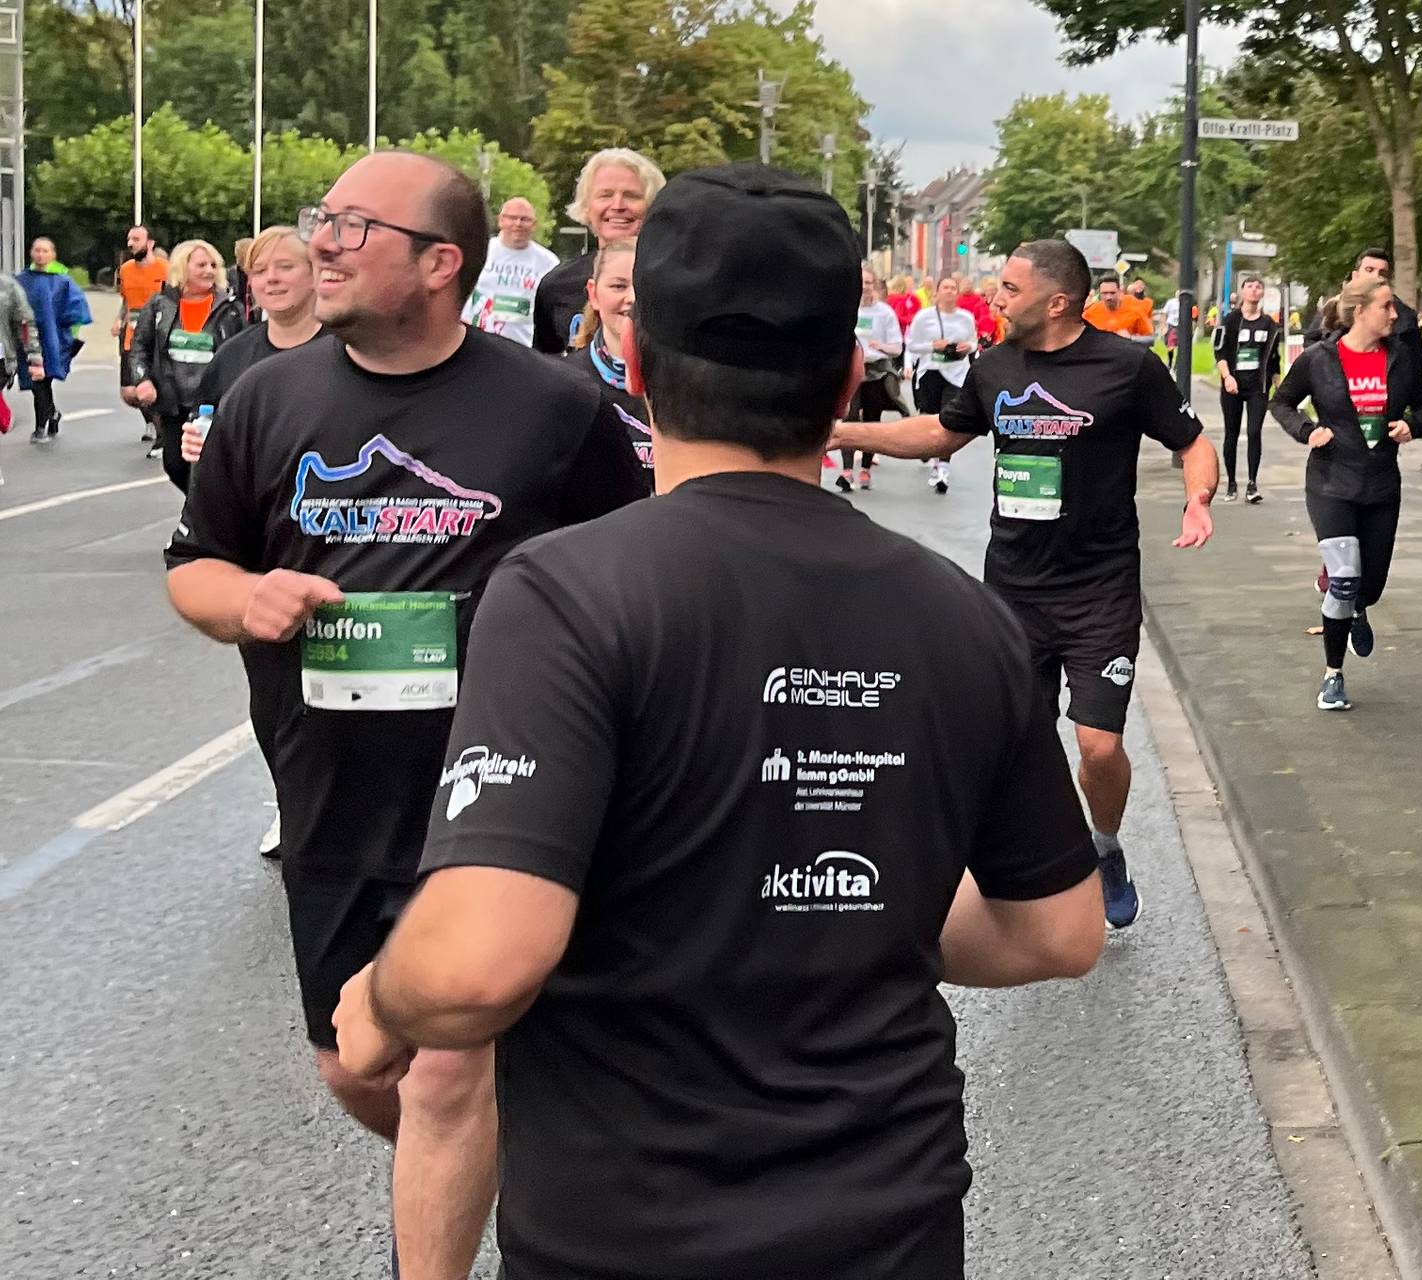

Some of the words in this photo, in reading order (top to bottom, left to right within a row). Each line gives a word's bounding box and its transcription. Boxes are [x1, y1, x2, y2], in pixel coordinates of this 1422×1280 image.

[1349, 376, 1388, 391] LWL
[299, 505, 484, 537] KALTSTART
[306, 617, 383, 640] Steffen
[790, 668, 897, 689] EINHAUS
[791, 687, 880, 708] MOBILE
[808, 750, 905, 768] Marien-Hospital
[761, 864, 870, 898] aktivita
